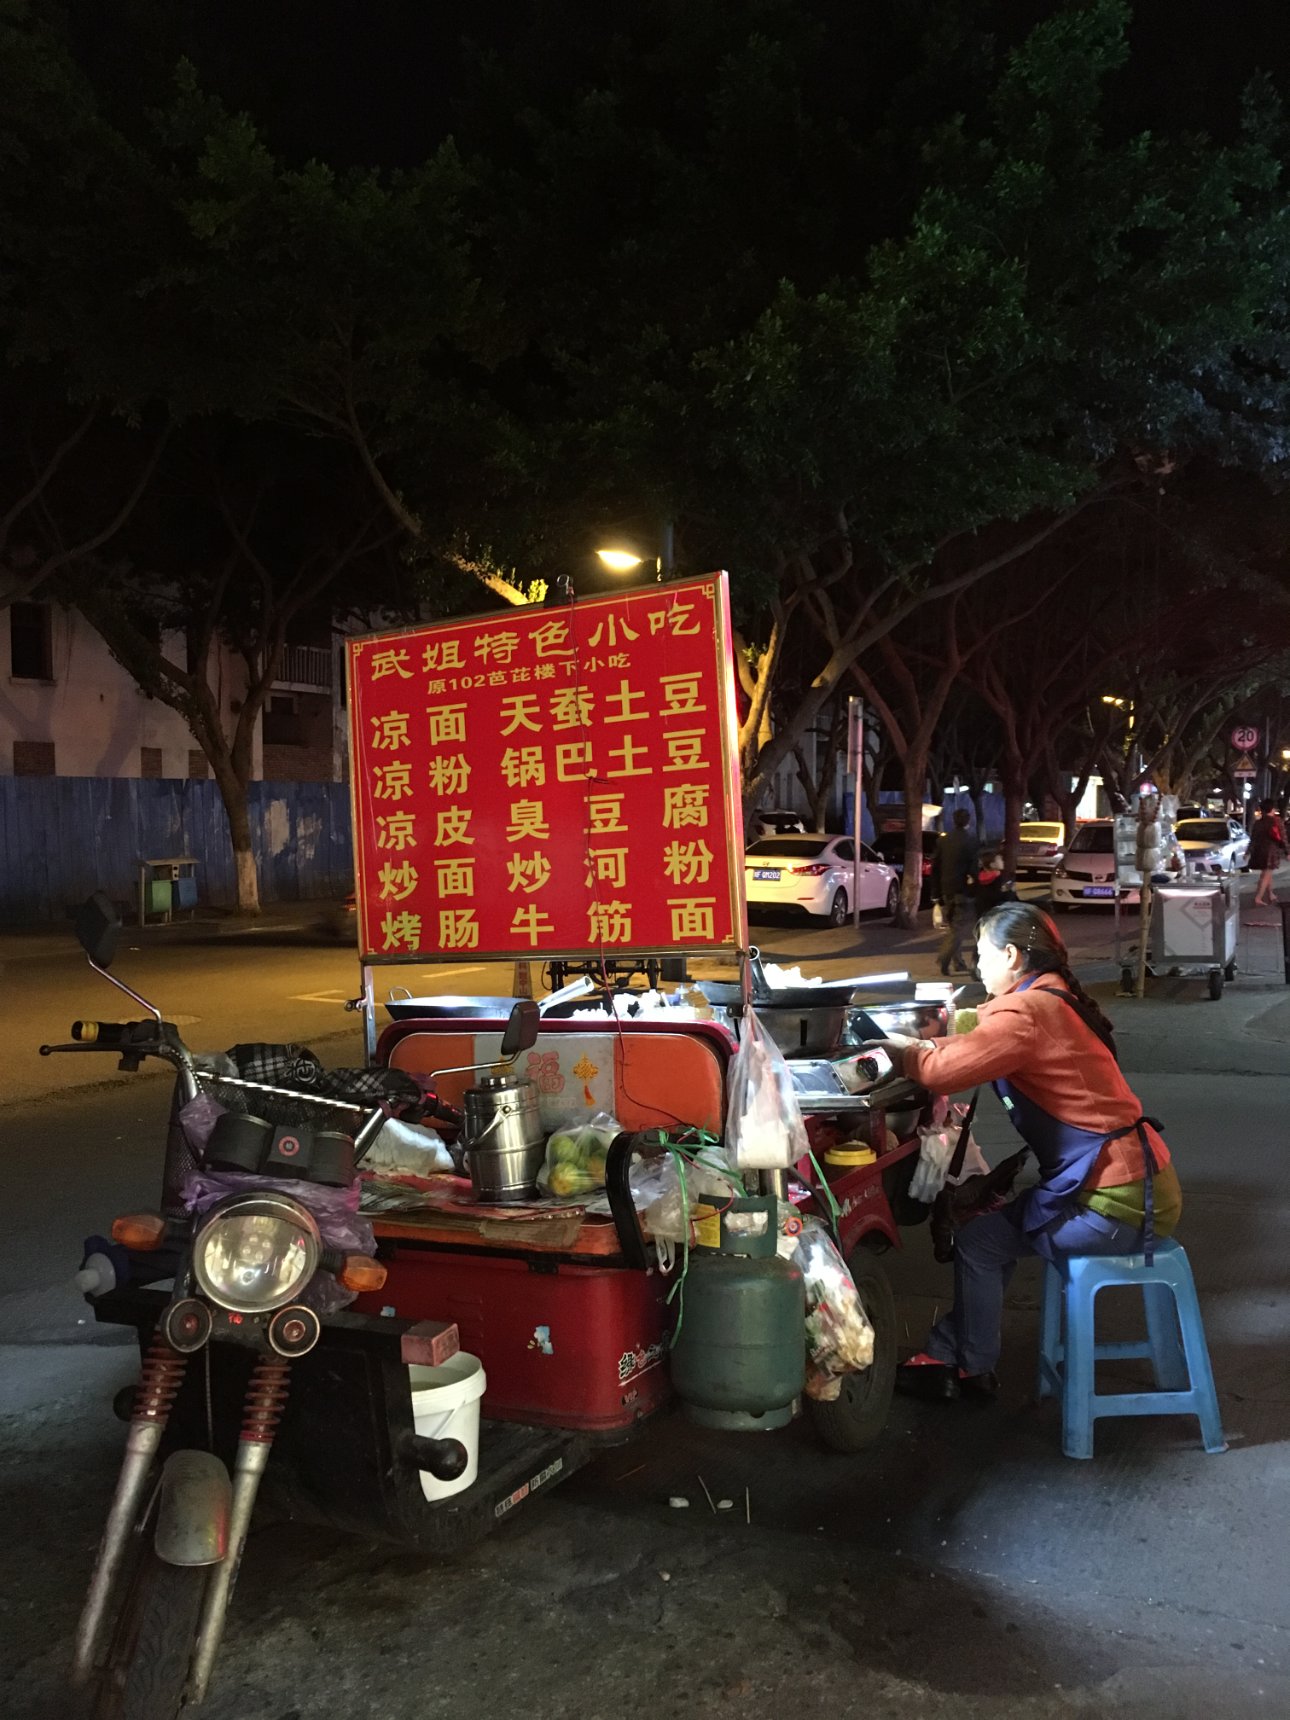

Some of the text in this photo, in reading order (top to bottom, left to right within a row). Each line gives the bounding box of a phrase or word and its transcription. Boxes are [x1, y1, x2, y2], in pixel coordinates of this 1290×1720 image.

[371, 602, 701, 681] 武姐特色小吃
[370, 671, 707, 751] 凉面 天蚕土豆
[1238, 730, 1254, 742] 20
[373, 728, 710, 801] 凉粉 锅巴土豆
[376, 783, 710, 851] 凉皮 臭豆腐
[378, 839, 714, 901] 炒面 炒河粉
[381, 896, 717, 951] 烤肠 牛筋面
[525, 1050, 566, 1094] 福
